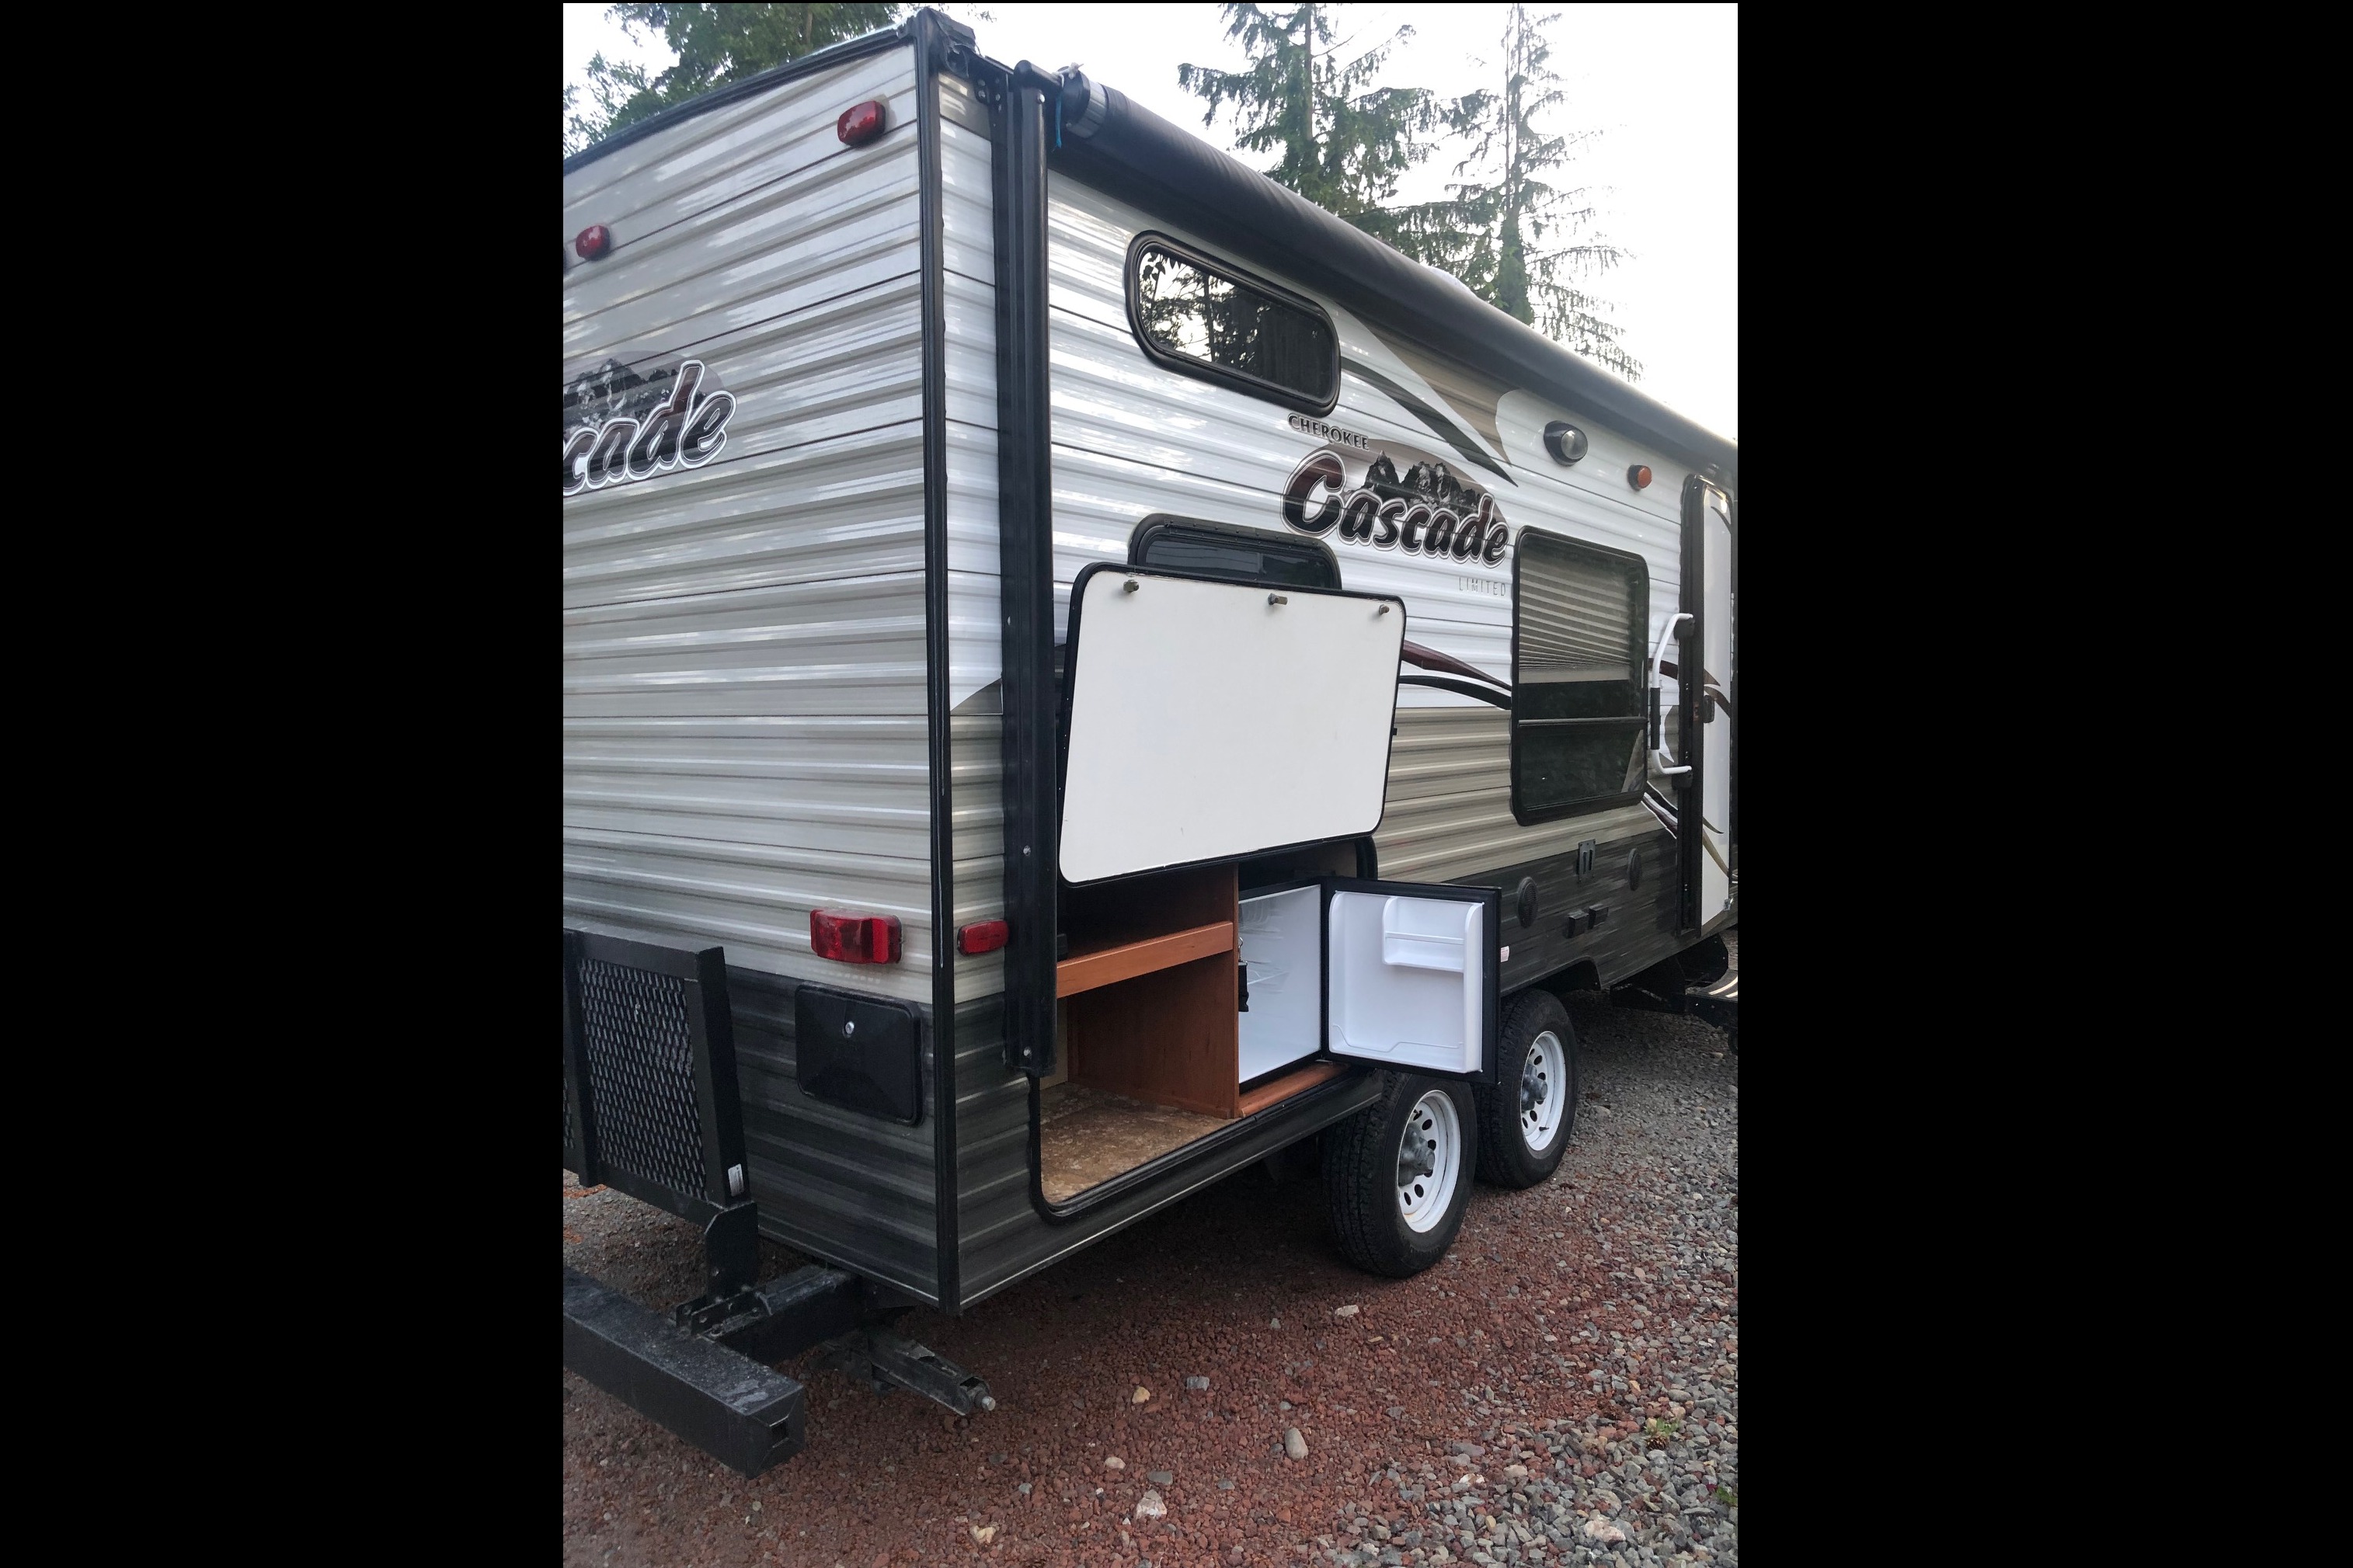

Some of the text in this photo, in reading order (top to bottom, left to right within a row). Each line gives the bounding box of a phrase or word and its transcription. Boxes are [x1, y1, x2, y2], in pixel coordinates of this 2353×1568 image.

[1288, 413, 1370, 451] CHEROKEE
[1281, 449, 1510, 568] Cascade
[1459, 577, 1506, 596] LIMITED
